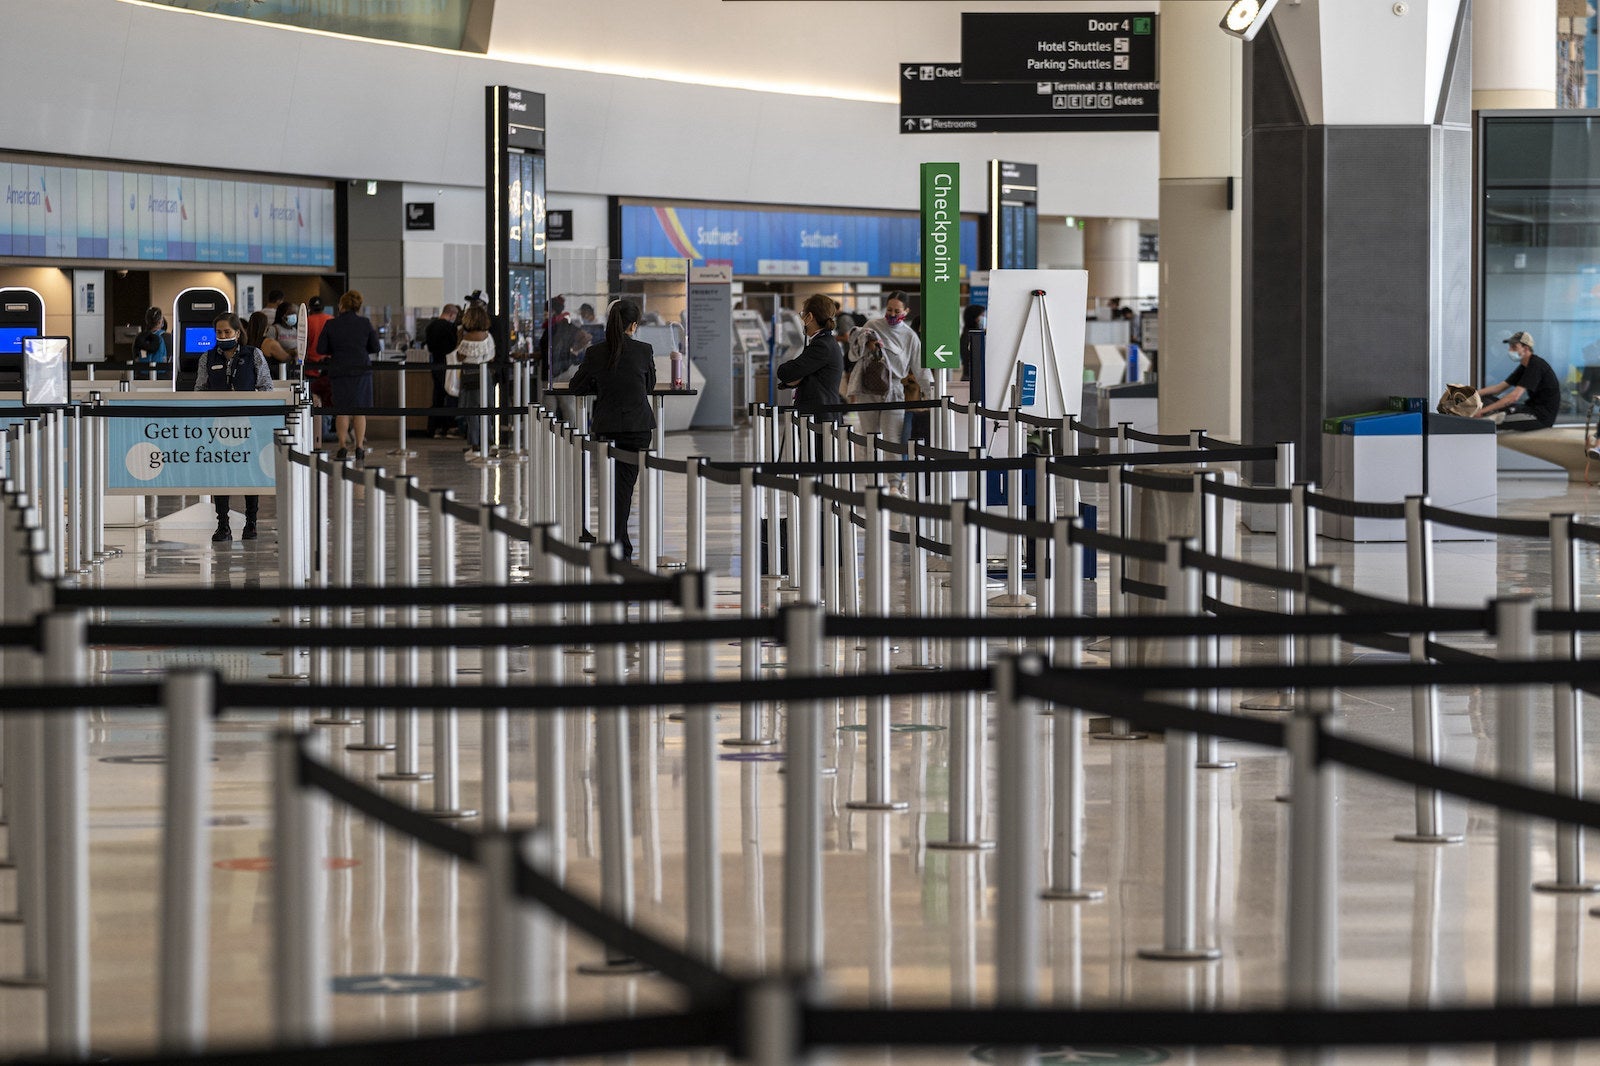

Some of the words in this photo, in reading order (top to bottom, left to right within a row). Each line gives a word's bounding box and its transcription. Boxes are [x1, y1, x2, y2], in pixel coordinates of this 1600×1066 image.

[1088, 19, 1118, 31] Door
[1121, 19, 1129, 31] 4
[1038, 41, 1066, 51] Hotel
[1068, 41, 1111, 51] Shuttles
[935, 67, 961, 77] Chec
[1027, 58, 1066, 71] Parking
[1068, 58, 1111, 69] Shuttles
[1054, 82, 1095, 91] Terminal
[1097, 82, 1104, 91] 3
[1105, 82, 1112, 91] &
[1114, 95, 1144, 106] Gates
[932, 121, 977, 129] Restrooms
[6, 184, 41, 206] American
[148, 194, 177, 214] American
[269, 203, 296, 221] American
[697, 226, 739, 246] Southwest
[930, 173, 952, 282] Checkpoint
[800, 230, 839, 248] Southwest
[144, 423, 179, 440] Get
[183, 424, 203, 440] to
[207, 426, 252, 444] your
[149, 448, 190, 469] gate
[195, 445, 251, 463] faster
